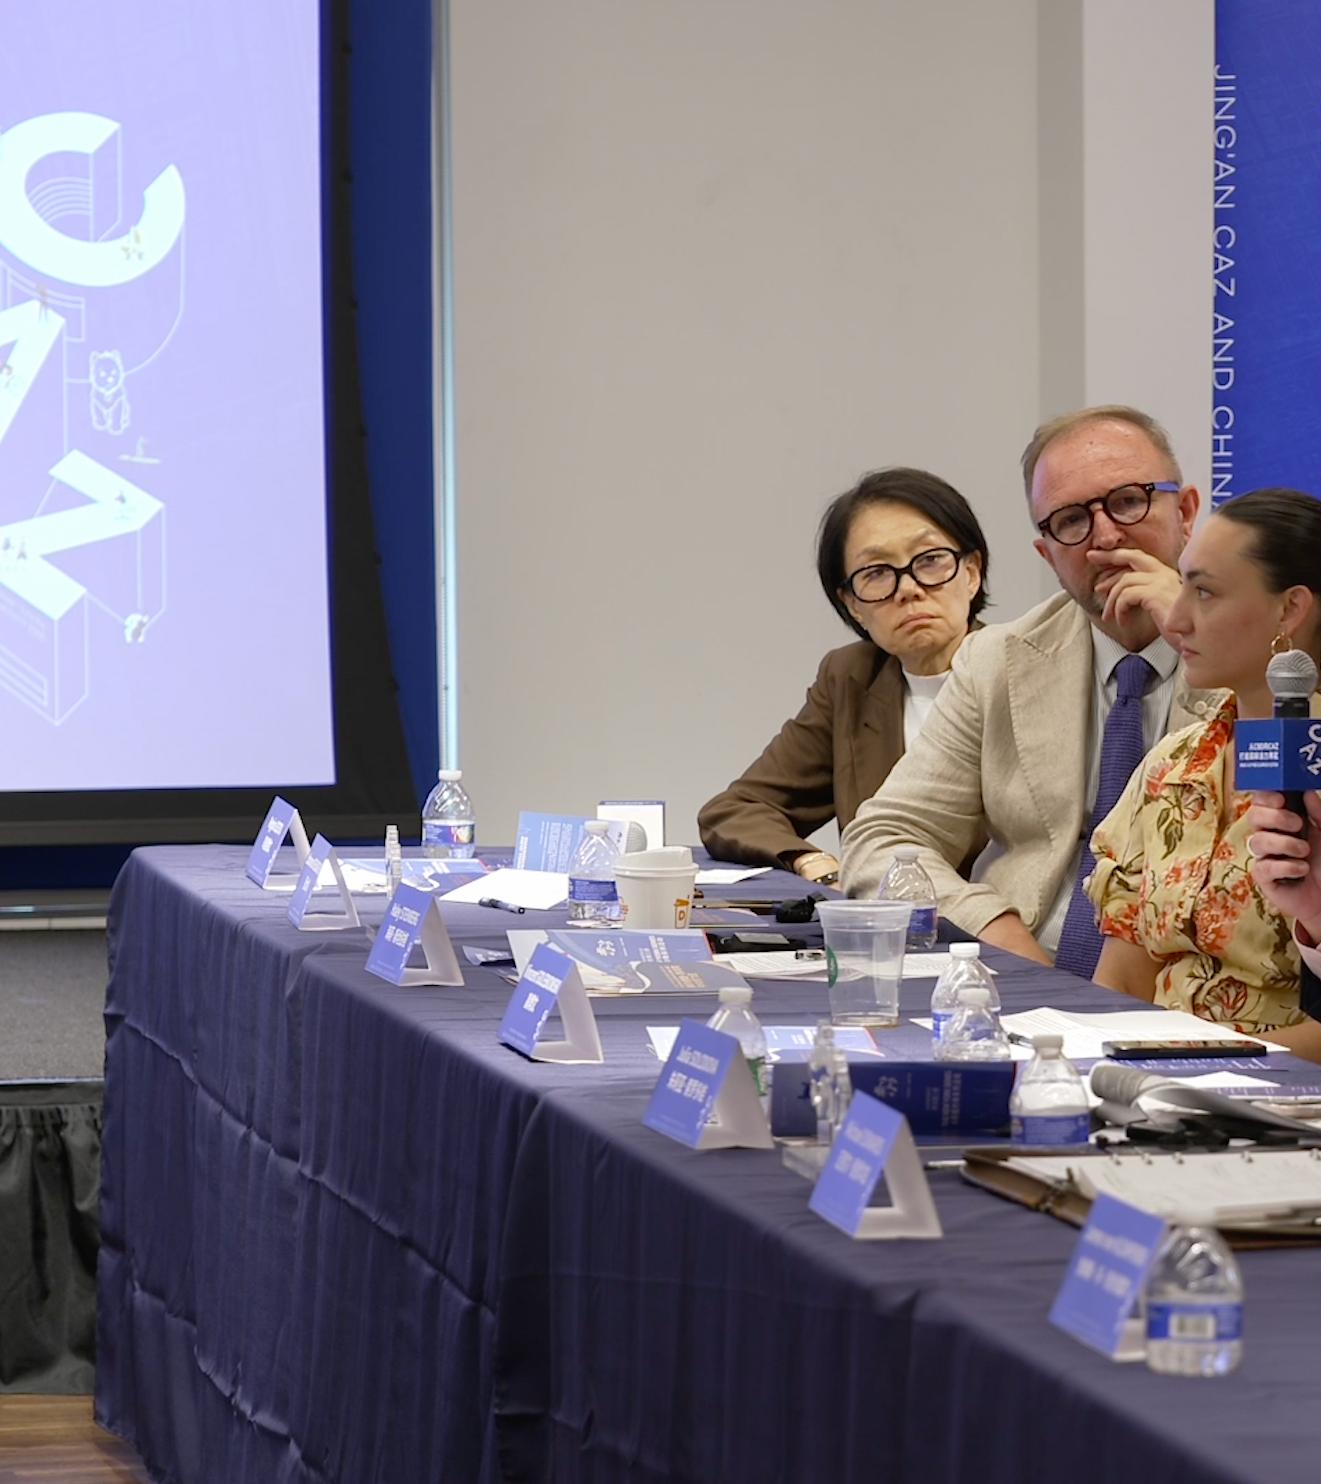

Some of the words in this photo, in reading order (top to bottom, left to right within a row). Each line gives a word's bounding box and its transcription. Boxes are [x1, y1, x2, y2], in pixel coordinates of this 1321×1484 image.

[1214, 64, 1237, 208] JING'AN
[1213, 225, 1236, 297] CAZ
[1213, 312, 1235, 390] AND
[1211, 405, 1235, 511] CHIN
